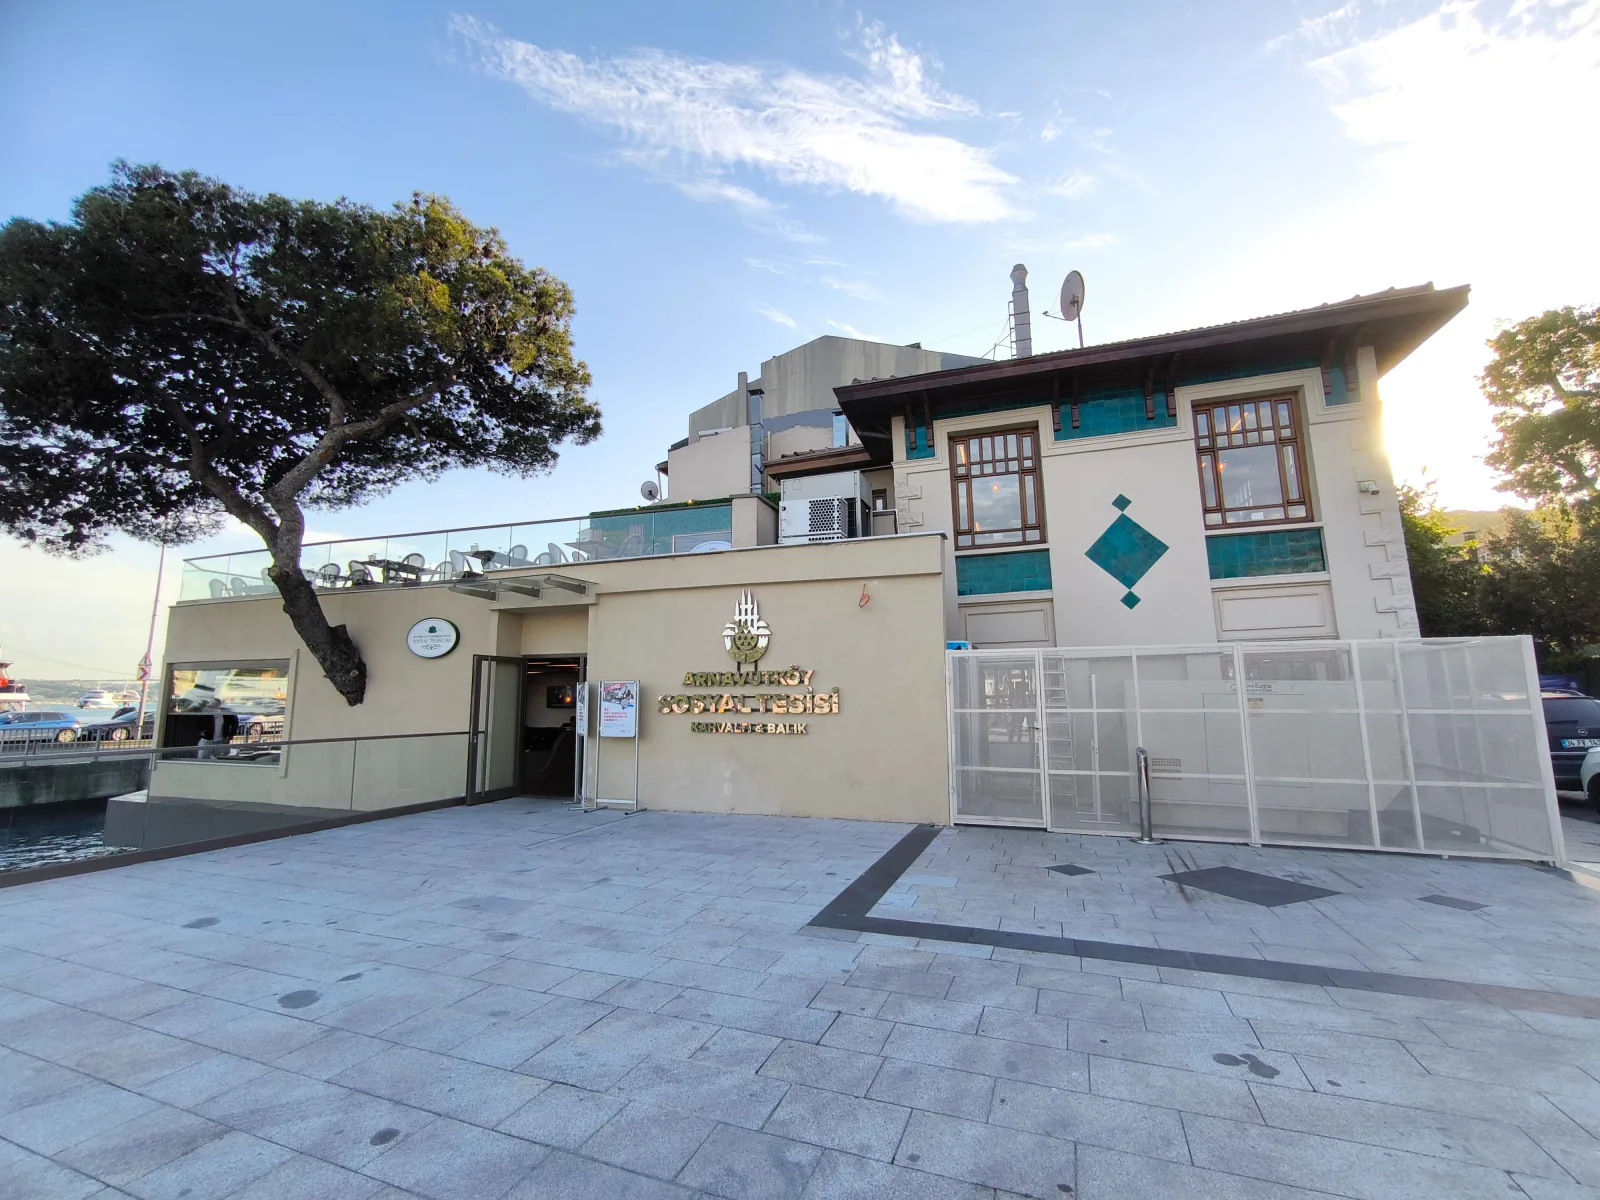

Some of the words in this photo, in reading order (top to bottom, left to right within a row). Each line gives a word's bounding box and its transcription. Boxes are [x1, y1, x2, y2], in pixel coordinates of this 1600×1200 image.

[682, 664, 814, 686] ARNAVUTKÖY
[658, 693, 752, 714] SOSYAL
[755, 686, 840, 714] TESİSİ
[691, 721, 751, 734] KAHVALTI
[767, 722, 808, 734] BALIK
